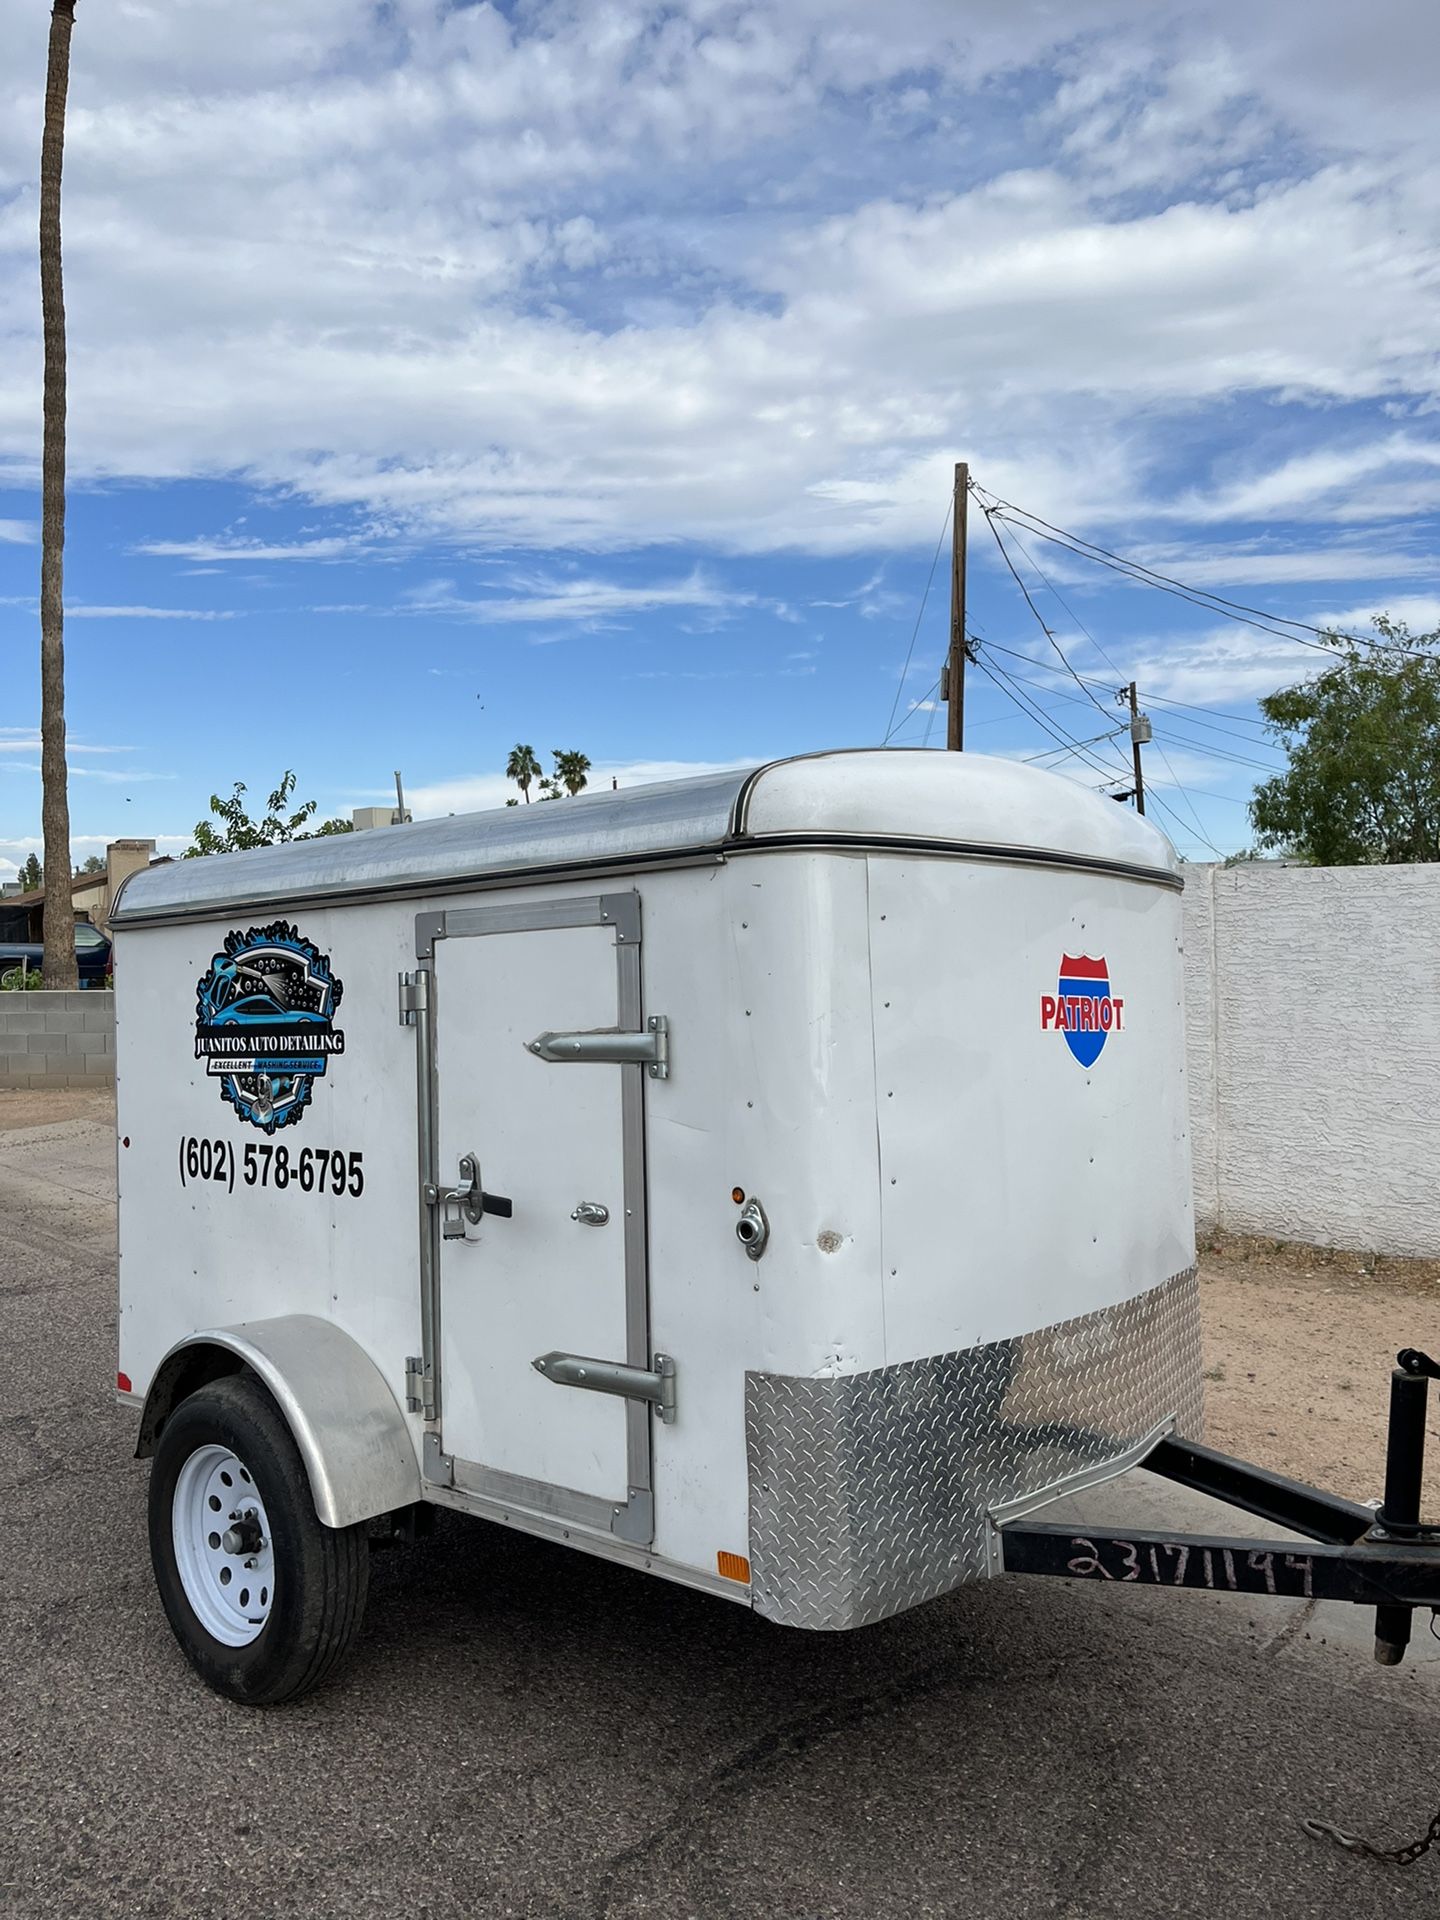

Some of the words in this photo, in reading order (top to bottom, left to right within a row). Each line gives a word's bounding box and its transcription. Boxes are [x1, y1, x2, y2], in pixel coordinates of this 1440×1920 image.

[1041, 995, 1124, 1031] PATRIOT
[196, 1036, 247, 1056] JUANITOS
[248, 1036, 278, 1052] AUTO
[279, 1034, 343, 1051] DETAILING
[179, 1136, 235, 1194] (602)
[243, 1143, 364, 1198] 578-6795
